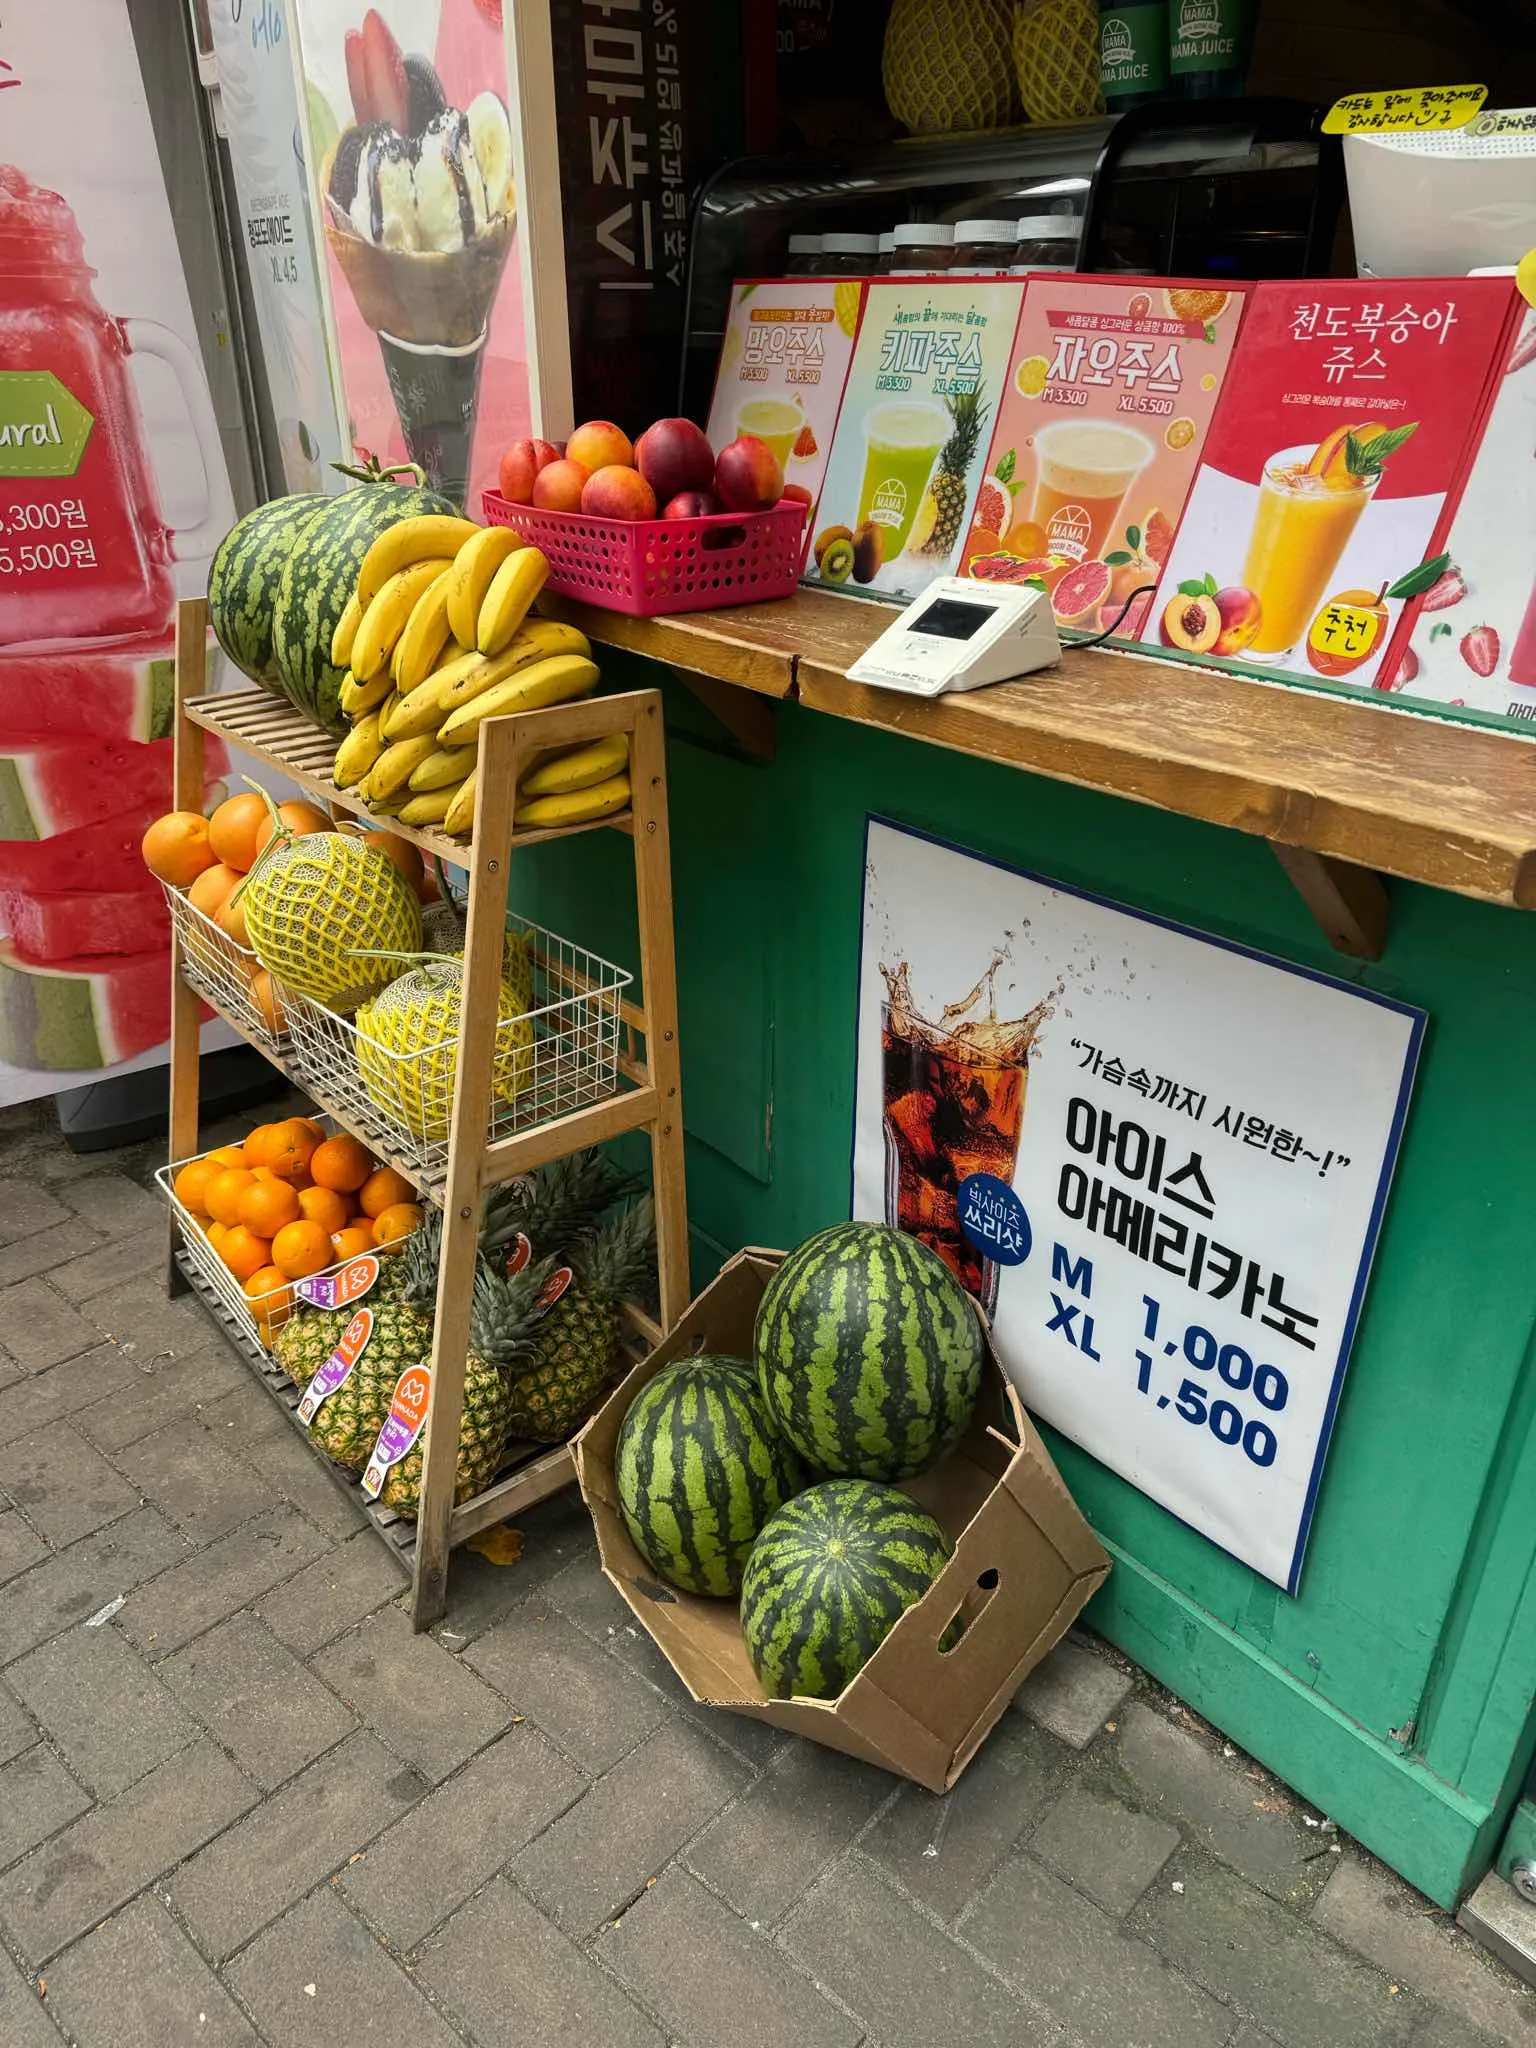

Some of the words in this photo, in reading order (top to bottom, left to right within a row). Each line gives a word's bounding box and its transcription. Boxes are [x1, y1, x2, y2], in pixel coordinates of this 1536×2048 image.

[1183, 6, 1213, 21] MAMA
[1171, 43, 1198, 58] MAMA
[1200, 39, 1234, 56] JUICE
[1118, 64, 1149, 80] JUICE
[1348, 112, 1414, 128] 감사합니다
[271, 256, 283, 285] XL
[1162, 323, 1186, 335] 100%
[1288, 302, 1458, 345] 천도복숭아
[880, 330, 982, 377] 키파주스
[1045, 335, 1183, 394] 자오주스
[1322, 346, 1387, 384] 쥬스
[933, 379, 947, 393] XL
[1042, 387, 1054, 403] M
[1118, 395, 1136, 411] XL
[0, 500, 88, 536] ,300원
[1051, 523, 1083, 541] MAMA
[1324, 608, 1368, 651] 추천
[1065, 1096, 1217, 1221] 아이스
[968, 1187, 1020, 1231] 빅사이즈
[963, 1205, 1023, 1257] 쓰리샷
[1051, 1241, 1093, 1300] M
[1057, 1163, 1320, 1352] 아메리카노
[1044, 1290, 1101, 1363] XL
